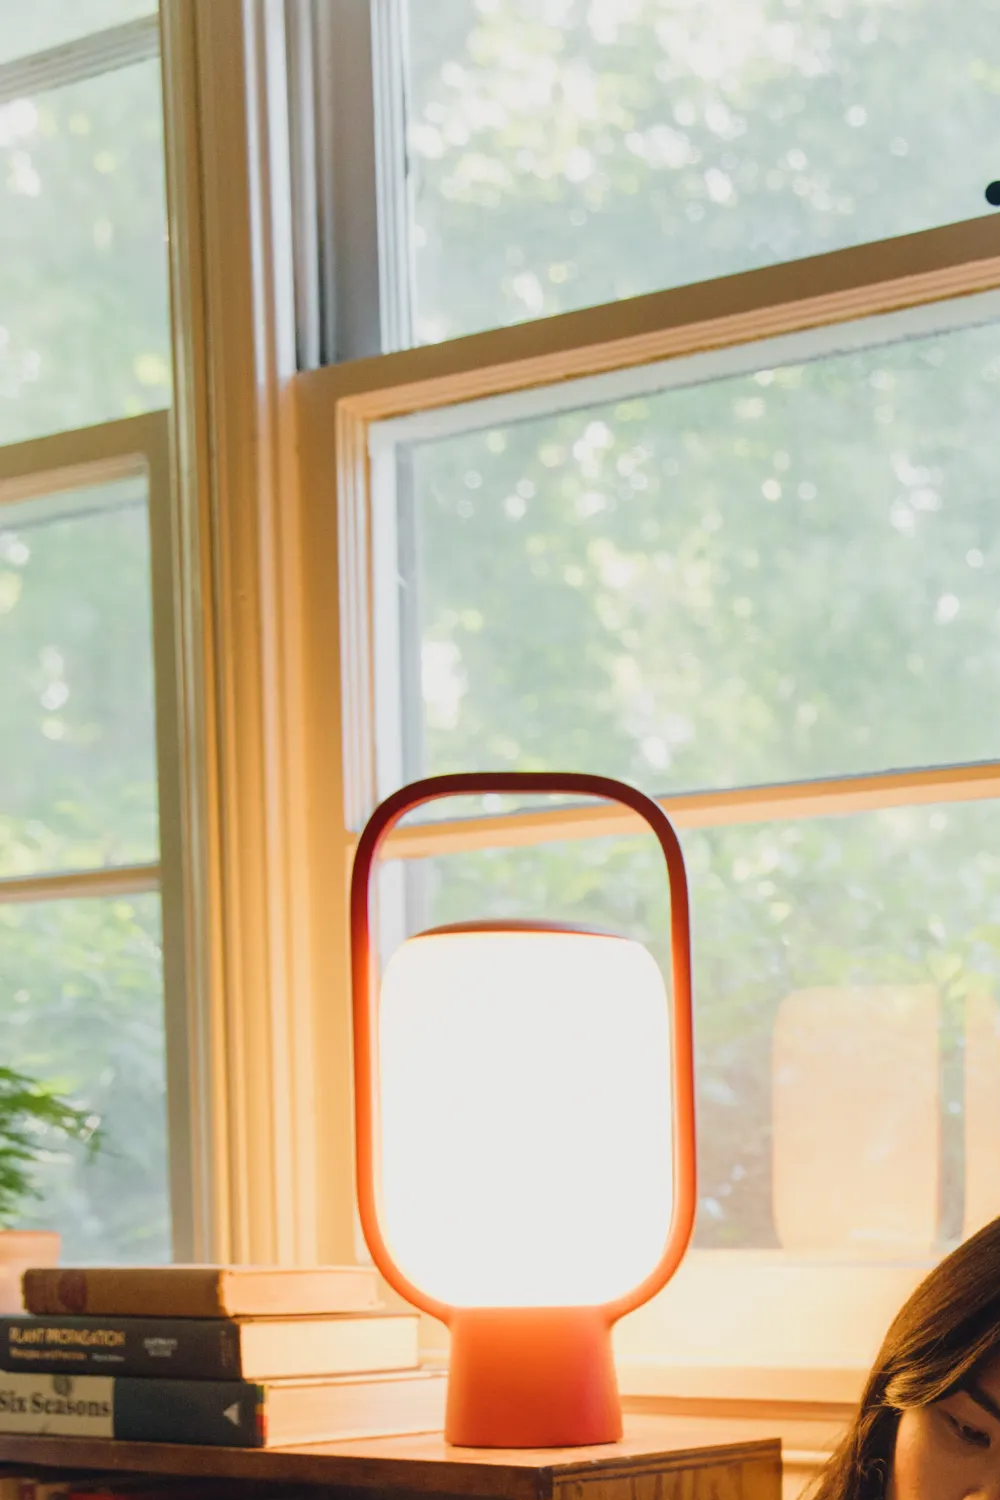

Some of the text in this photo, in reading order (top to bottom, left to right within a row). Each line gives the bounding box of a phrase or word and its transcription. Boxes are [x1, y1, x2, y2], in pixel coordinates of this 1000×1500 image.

[8, 1326, 45, 1345] PLANT
[0, 1389, 110, 1416] Six Seasons
